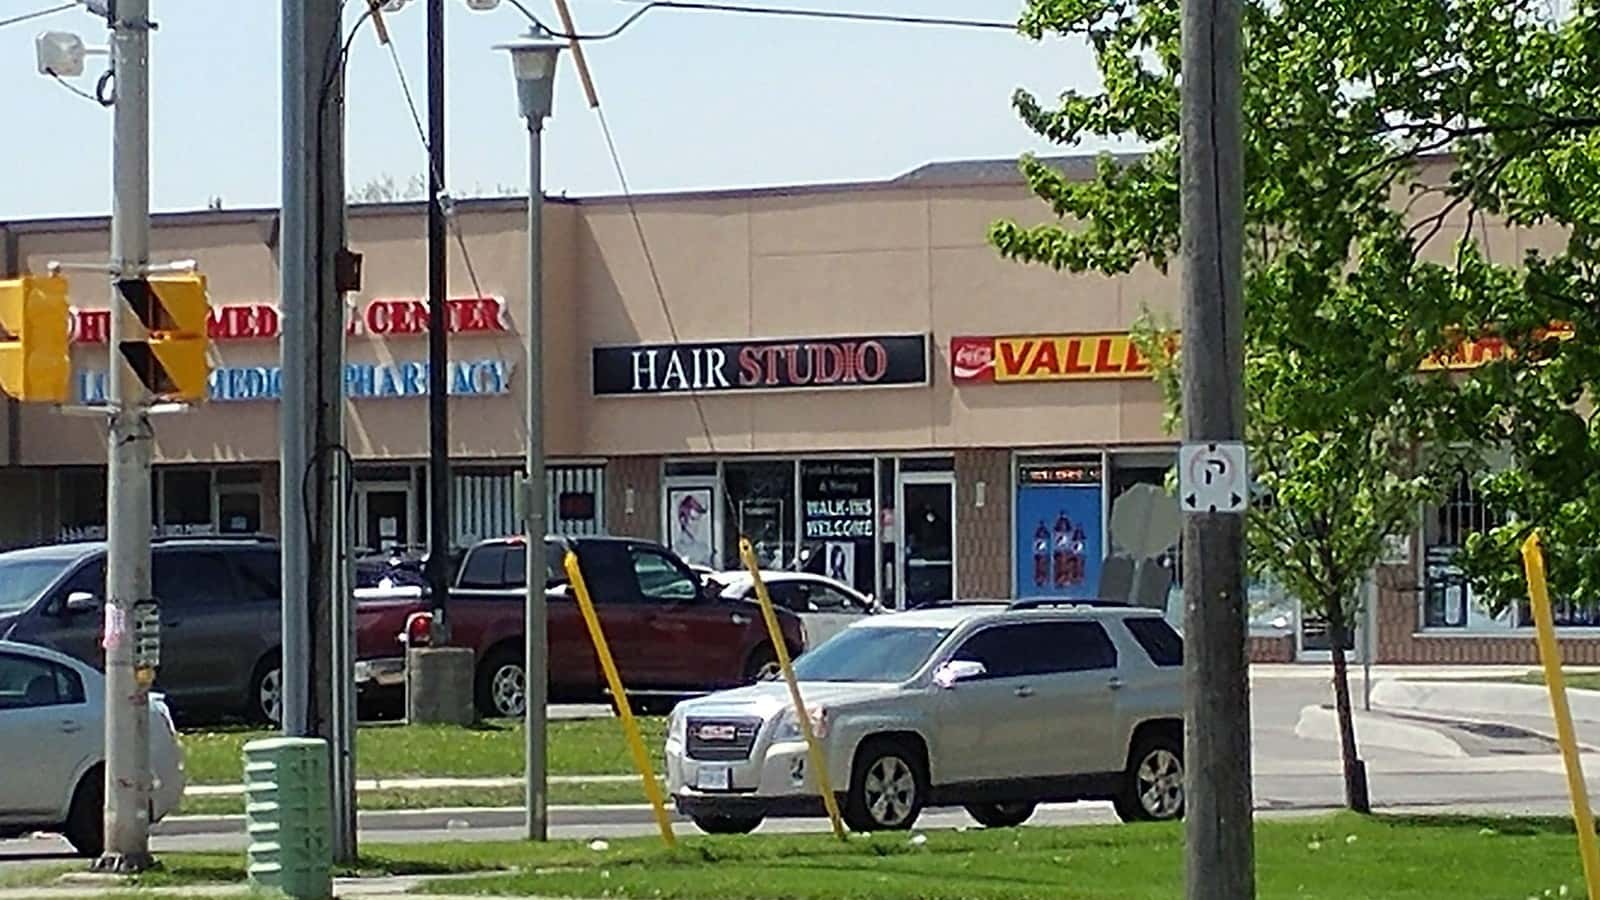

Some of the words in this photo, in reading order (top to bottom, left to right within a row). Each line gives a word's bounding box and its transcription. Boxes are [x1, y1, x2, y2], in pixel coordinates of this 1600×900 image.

[366, 297, 508, 336] CENTER
[630, 346, 731, 391] HAIR
[738, 340, 888, 387] STUDIO
[999, 336, 1177, 376] VALLE
